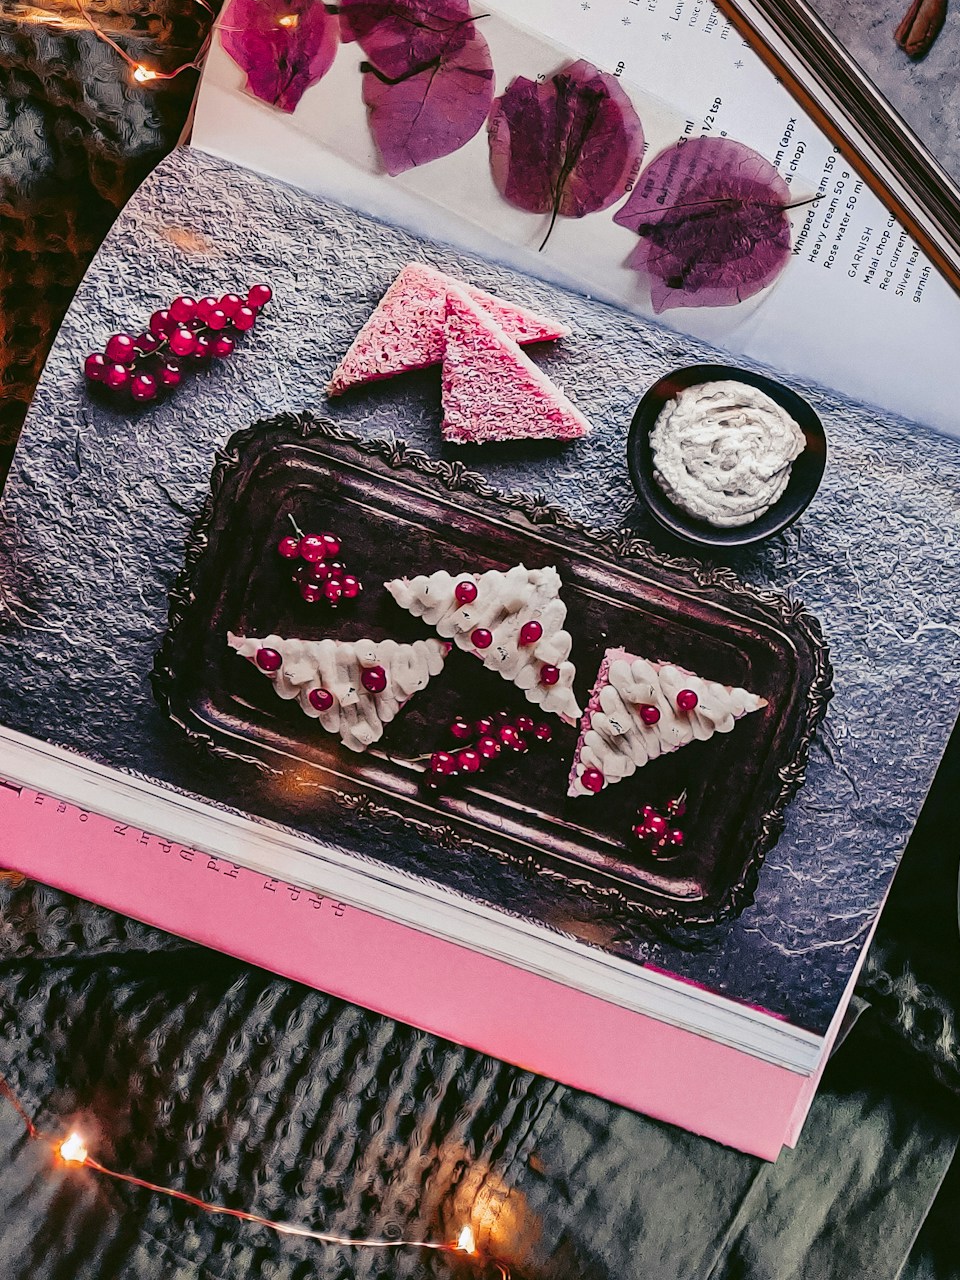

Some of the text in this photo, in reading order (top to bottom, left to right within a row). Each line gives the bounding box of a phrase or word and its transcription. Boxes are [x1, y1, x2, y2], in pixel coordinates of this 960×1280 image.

[700, 96, 722, 132] 1/2 tsp
[778, 116, 798, 148] (appx
[787, 140, 807, 172] chop)
[791, 155, 836, 257] Whipped 150
[807, 179, 845, 263] Heavy cream 50
[823, 179, 863, 269] Rose water 50 ml
[847, 226, 873, 278] GARNISH
[863, 229, 891, 284] Malai chop
[894, 267, 912, 296] Silver
[910, 264, 932, 303] garnish
